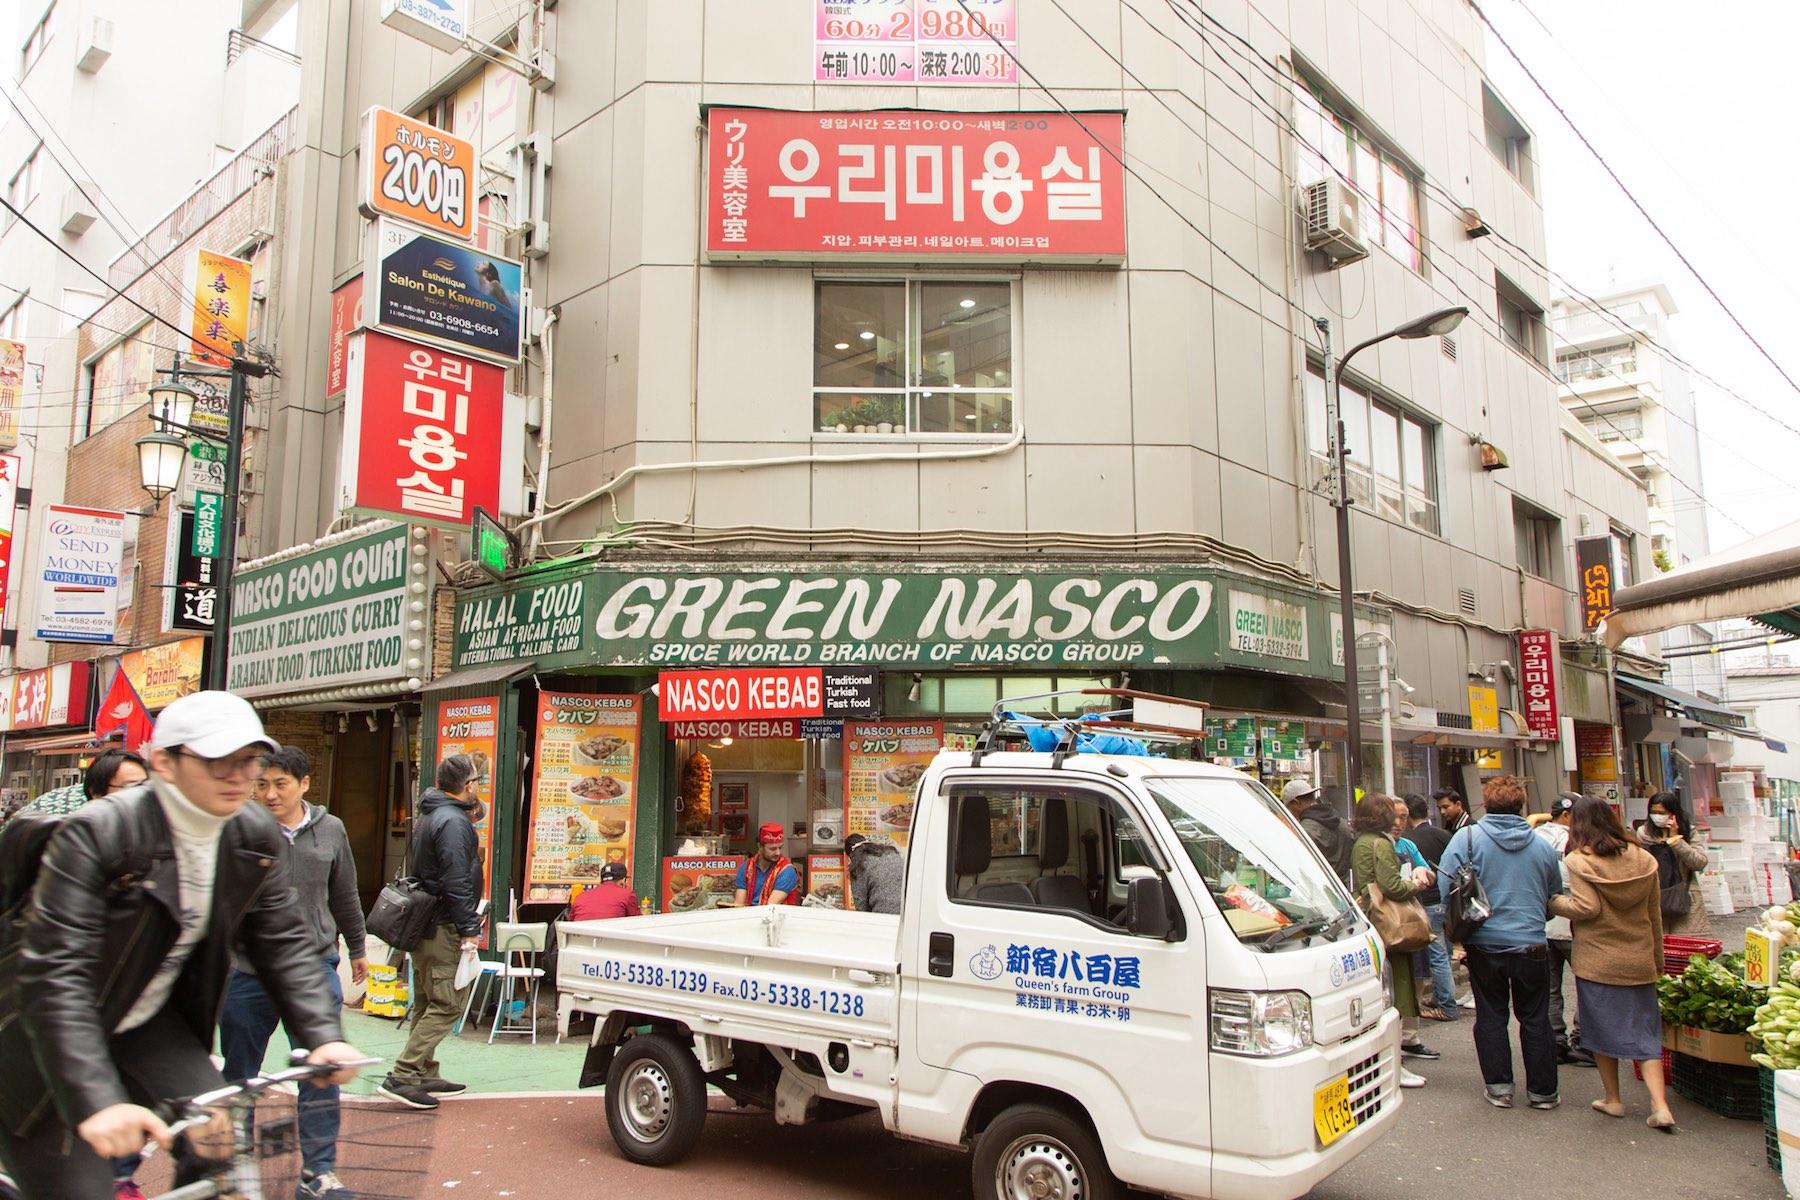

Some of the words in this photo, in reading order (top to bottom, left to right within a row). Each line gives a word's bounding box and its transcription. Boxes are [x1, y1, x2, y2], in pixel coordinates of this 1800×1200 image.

[826, 19, 882, 38] 60分
[819, 118, 879, 130] 영업시간
[396, 124, 456, 161] ホルモン
[381, 143, 466, 229] 200円
[721, 118, 749, 243] ウリ美容室
[768, 138, 1103, 226] 우리미용실
[388, 231, 407, 245] 3F
[990, 236, 1050, 248] 메이크업
[421, 269, 467, 290] Esthétique
[387, 271, 425, 292] Salon
[428, 283, 445, 297] De
[448, 289, 497, 313] Kawano
[429, 310, 500, 337] 03-6908-6654
[403, 349, 474, 393] 우리
[396, 380, 470, 520] 미용실
[59, 537, 109, 554] SEND
[47, 555, 118, 575] MONEY
[45, 571, 117, 587] WORLDWIDE
[234, 572, 284, 618] NASCO
[287, 557, 338, 605] FOOD
[341, 536, 406, 590] COURT
[182, 587, 217, 626] 道
[459, 594, 517, 634] HALAL
[527, 580, 583, 623] FOOD
[595, 577, 902, 640] GREEN
[916, 578, 1213, 642] NASCO
[231, 623, 276, 657] INDIAN
[277, 607, 348, 649] DELICIOUS
[352, 594, 404, 634] CURRY
[468, 629, 500, 650] ASIAN
[502, 622, 550, 645] AFRICAN
[551, 615, 582, 639] FOOD
[1235, 608, 1269, 635] GREEN
[1272, 616, 1303, 642] NASCO
[459, 647, 515, 666] INTERNATIONAL
[519, 639, 553, 658] CALLING
[556, 635, 580, 652] CARD
[649, 643, 722, 662] SPICE
[727, 643, 810, 662] WORLD
[819, 643, 920, 662] BRANCH
[930, 643, 963, 661] OF
[970, 643, 1053, 661] NASCO
[1062, 643, 1144, 661] GROUP
[229, 655, 273, 690] ARABIAN
[365, 635, 402, 670] FOOD
[145, 665, 177, 687] Barahi
[825, 675, 873, 686] Traditional
[1523, 644, 1551, 712] 우리미용실
[15, 671, 48, 723] 王将
[551, 696, 592, 707] NASCO
[594, 698, 633, 708] KEBAB
[666, 678, 740, 713] NASCO
[748, 676, 820, 711] KEBAB
[825, 686, 859, 697] Turkish
[446, 706, 469, 718] NASCO
[469, 704, 492, 716] KEBAB
[826, 698, 849, 709] Fast
[850, 697, 871, 708] food
[557, 709, 598, 724] ケバブ
[801, 718, 844, 727] Traditional
[449, 721, 472, 739] ケバブ
[673, 721, 732, 738] NASCO
[738, 721, 793, 737] KEBAB
[801, 725, 833, 733] Turkish
[821, 731, 841, 739] food
[855, 726, 894, 736] NASCO
[896, 726, 934, 735] KEBAB
[862, 738, 900, 753] ケバブ
[671, 861, 703, 869] NASCO
[706, 861, 737, 869] KEBAB
[1005, 943, 1142, 989] 新宿八百屋
[1015, 975, 1060, 993] Queen's
[1062, 982, 1090, 997] farm
[1092, 985, 1130, 1003] Group
[1015, 992, 1051, 1011] 業務卸
[1054, 997, 1131, 1022] 青果・お米・卵
